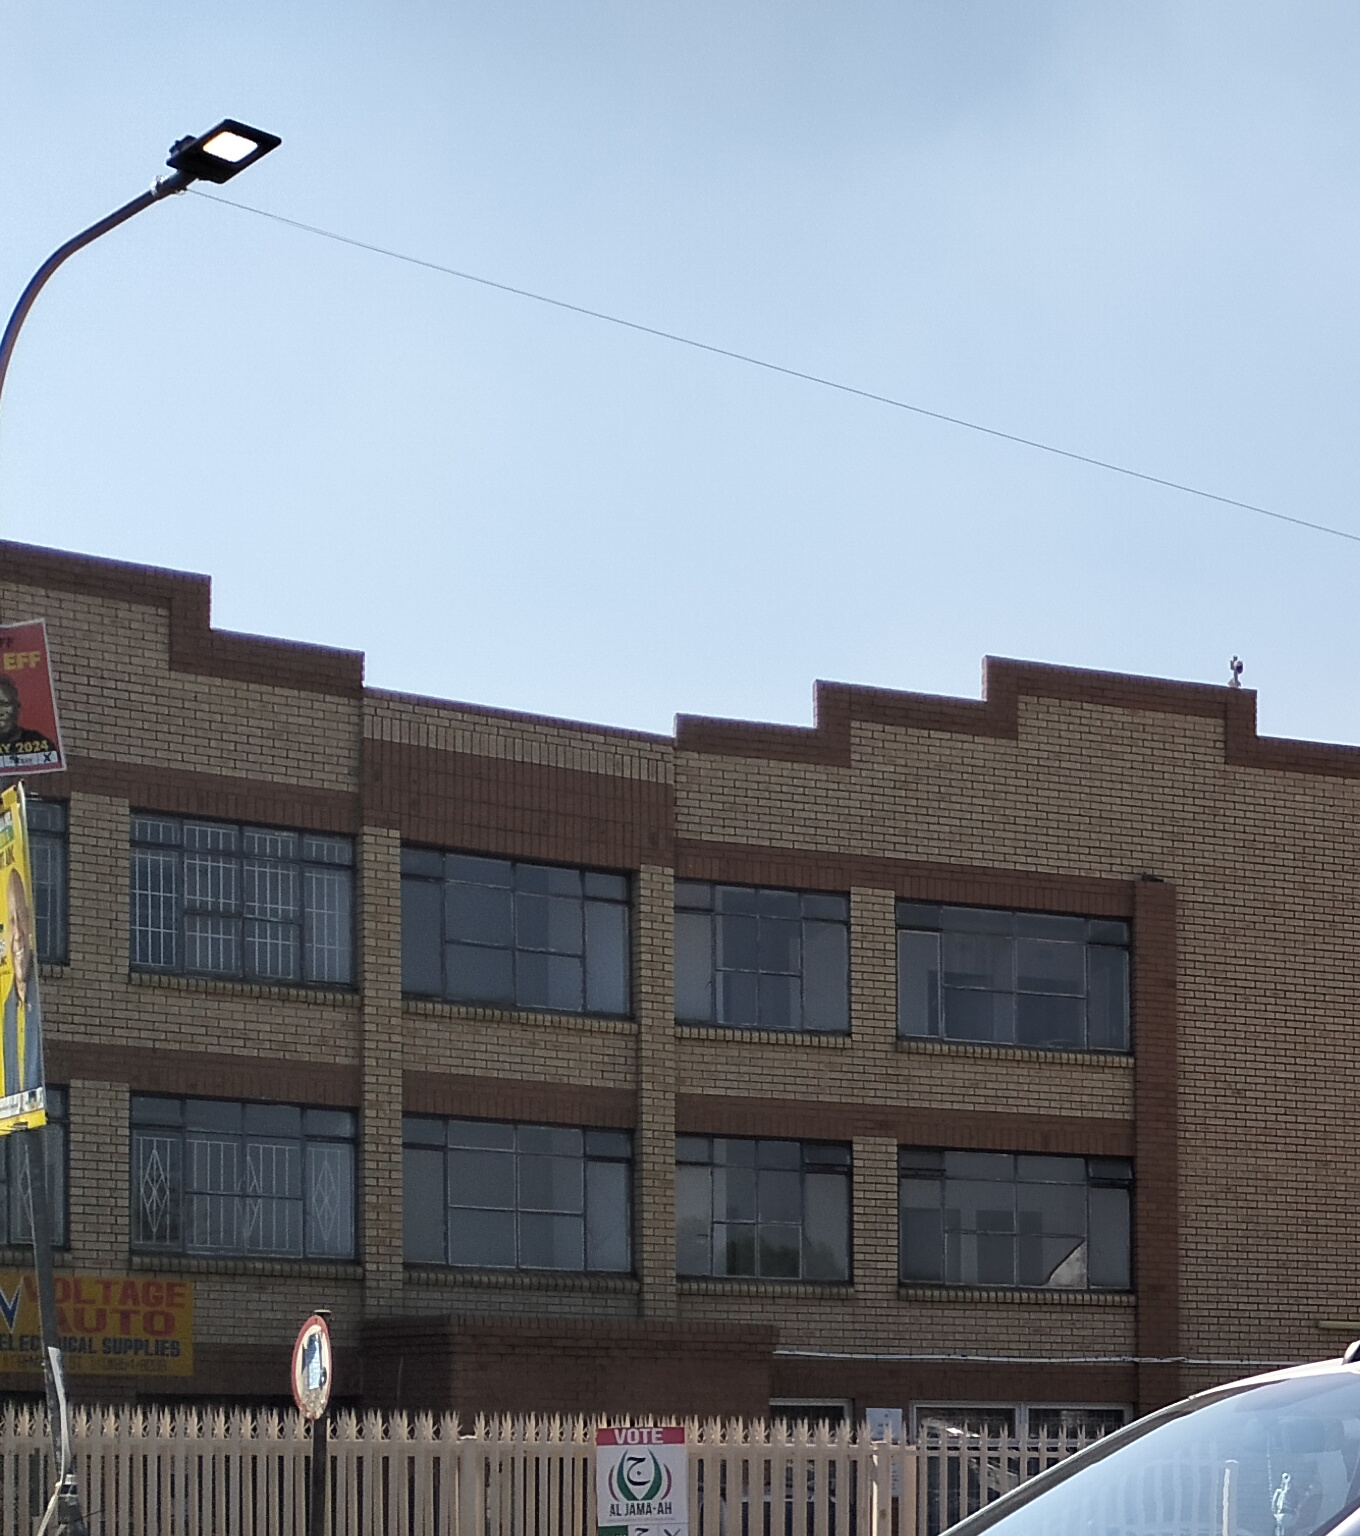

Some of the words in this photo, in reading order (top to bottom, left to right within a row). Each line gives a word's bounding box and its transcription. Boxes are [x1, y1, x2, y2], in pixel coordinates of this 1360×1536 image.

[3, 652, 41, 671] EFF
[15, 740, 49, 753] 2024
[22, 1276, 187, 1309] VOLTAGE
[55, 1306, 176, 1337] AUTO
[102, 1337, 180, 1357] SUPPLIES
[613, 1428, 664, 1444] VOTE
[609, 1503, 622, 1517] AL
[623, 1501, 673, 1517] JAMA-AH
